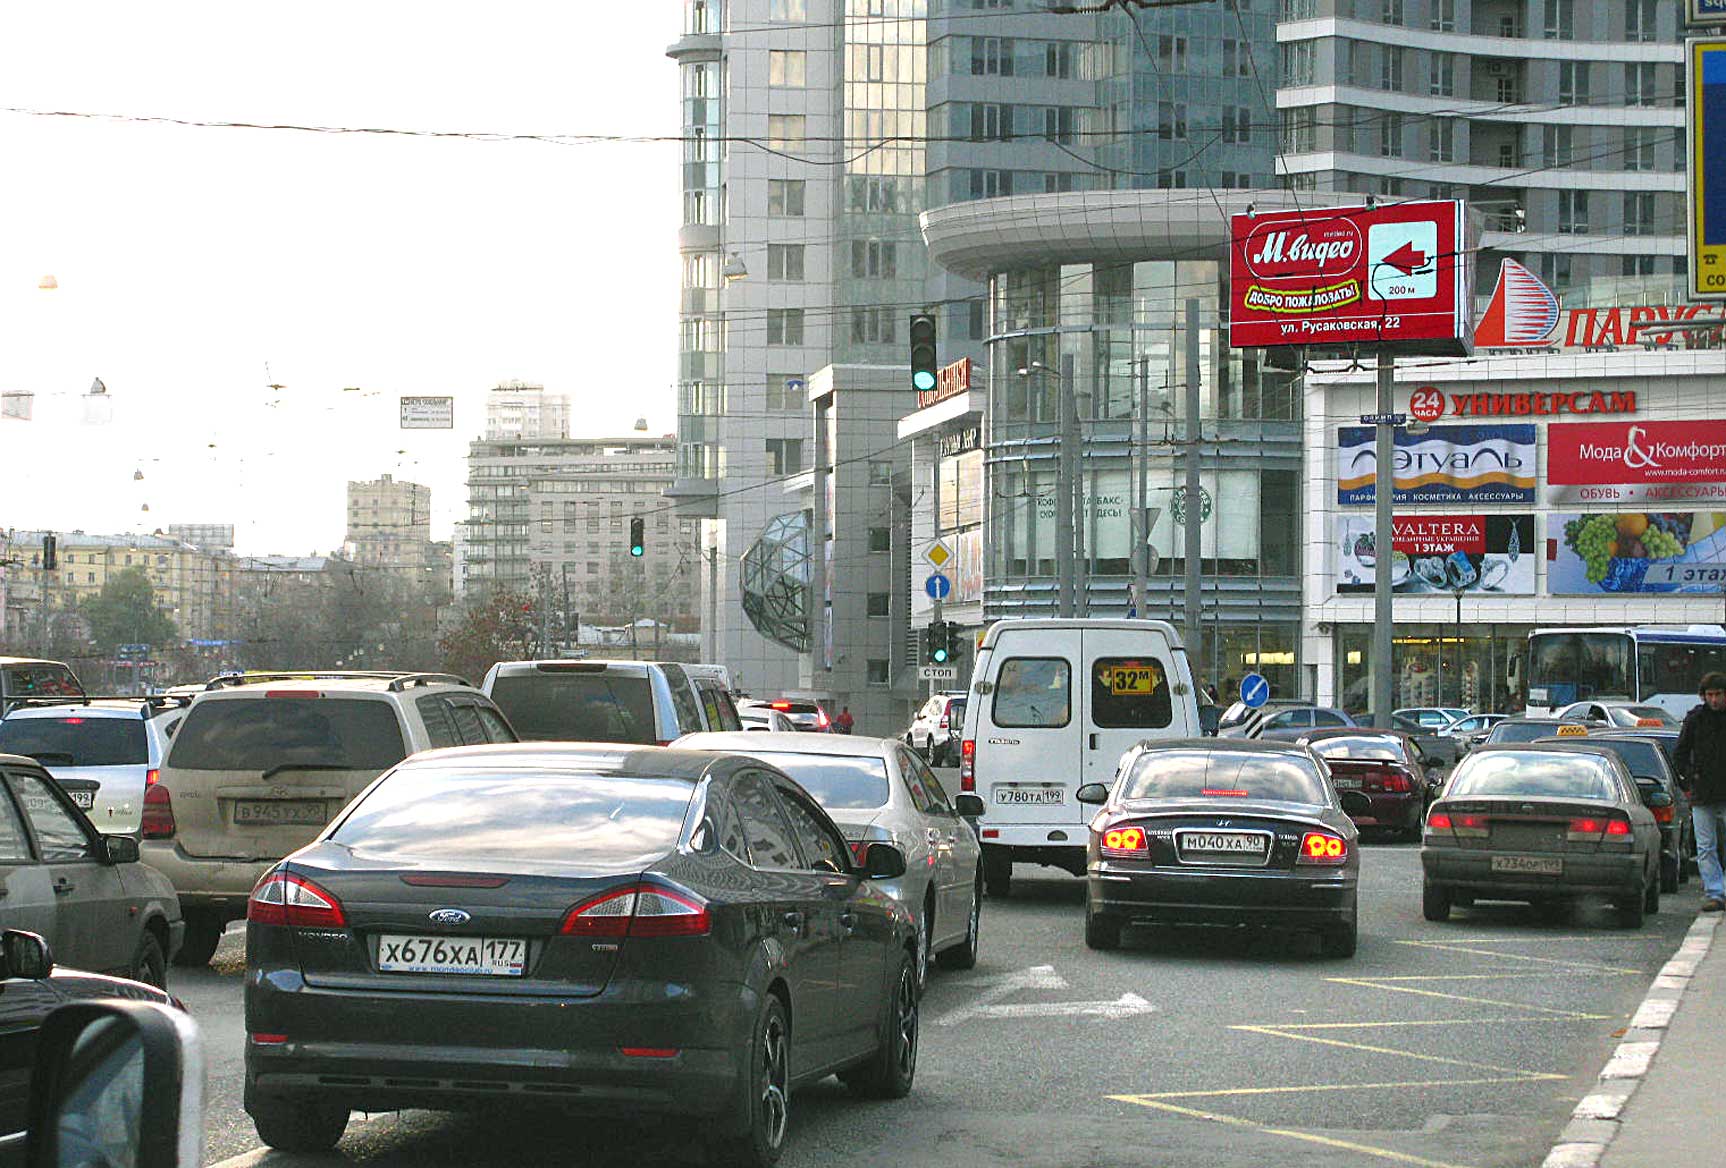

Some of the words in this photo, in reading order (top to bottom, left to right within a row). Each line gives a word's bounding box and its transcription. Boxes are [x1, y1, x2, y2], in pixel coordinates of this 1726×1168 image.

[1249, 291, 1282, 307] ДОБРО
[1285, 285, 1355, 308] ПОЖАЛОВАТЬ!
[1389, 286, 1406, 295] 200
[1281, 325, 1299, 336] ул.
[1301, 319, 1382, 334] Русаковская,
[1385, 317, 1401, 329] 22
[1564, 303, 1726, 347] ПАРУС
[1413, 391, 1440, 409] 24
[1450, 391, 1636, 417] УНИВЕРСАМ
[1414, 409, 1438, 417] ЧАСА
[1579, 444, 1622, 461] Мода
[1655, 441, 1726, 461] Комфорт
[1413, 493, 1462, 501] КОСМЕТИКА
[1468, 492, 1524, 500] АКСЕССУАРЫ
[1580, 488, 1620, 499] ОБУВЬ
[1037, 498, 1056, 507] КОФ
[1097, 509, 1122, 518] ДЕСЬ!
[1392, 523, 1480, 535] VALTERA
[1414, 543, 1420, 552] 1
[1422, 543, 1455, 552] ЭТАЖ
[1666, 565, 1675, 581] 1
[924, 668, 952, 678] СТОП
[1044, 790, 1061, 800] 199
[1187, 835, 1243, 850] М040ХА
[1247, 835, 1260, 846] 90
[437, 911, 462, 923] Ford
[385, 939, 478, 965] Х676ХА
[486, 941, 521, 960] 177
[492, 959, 510, 967] RUS
